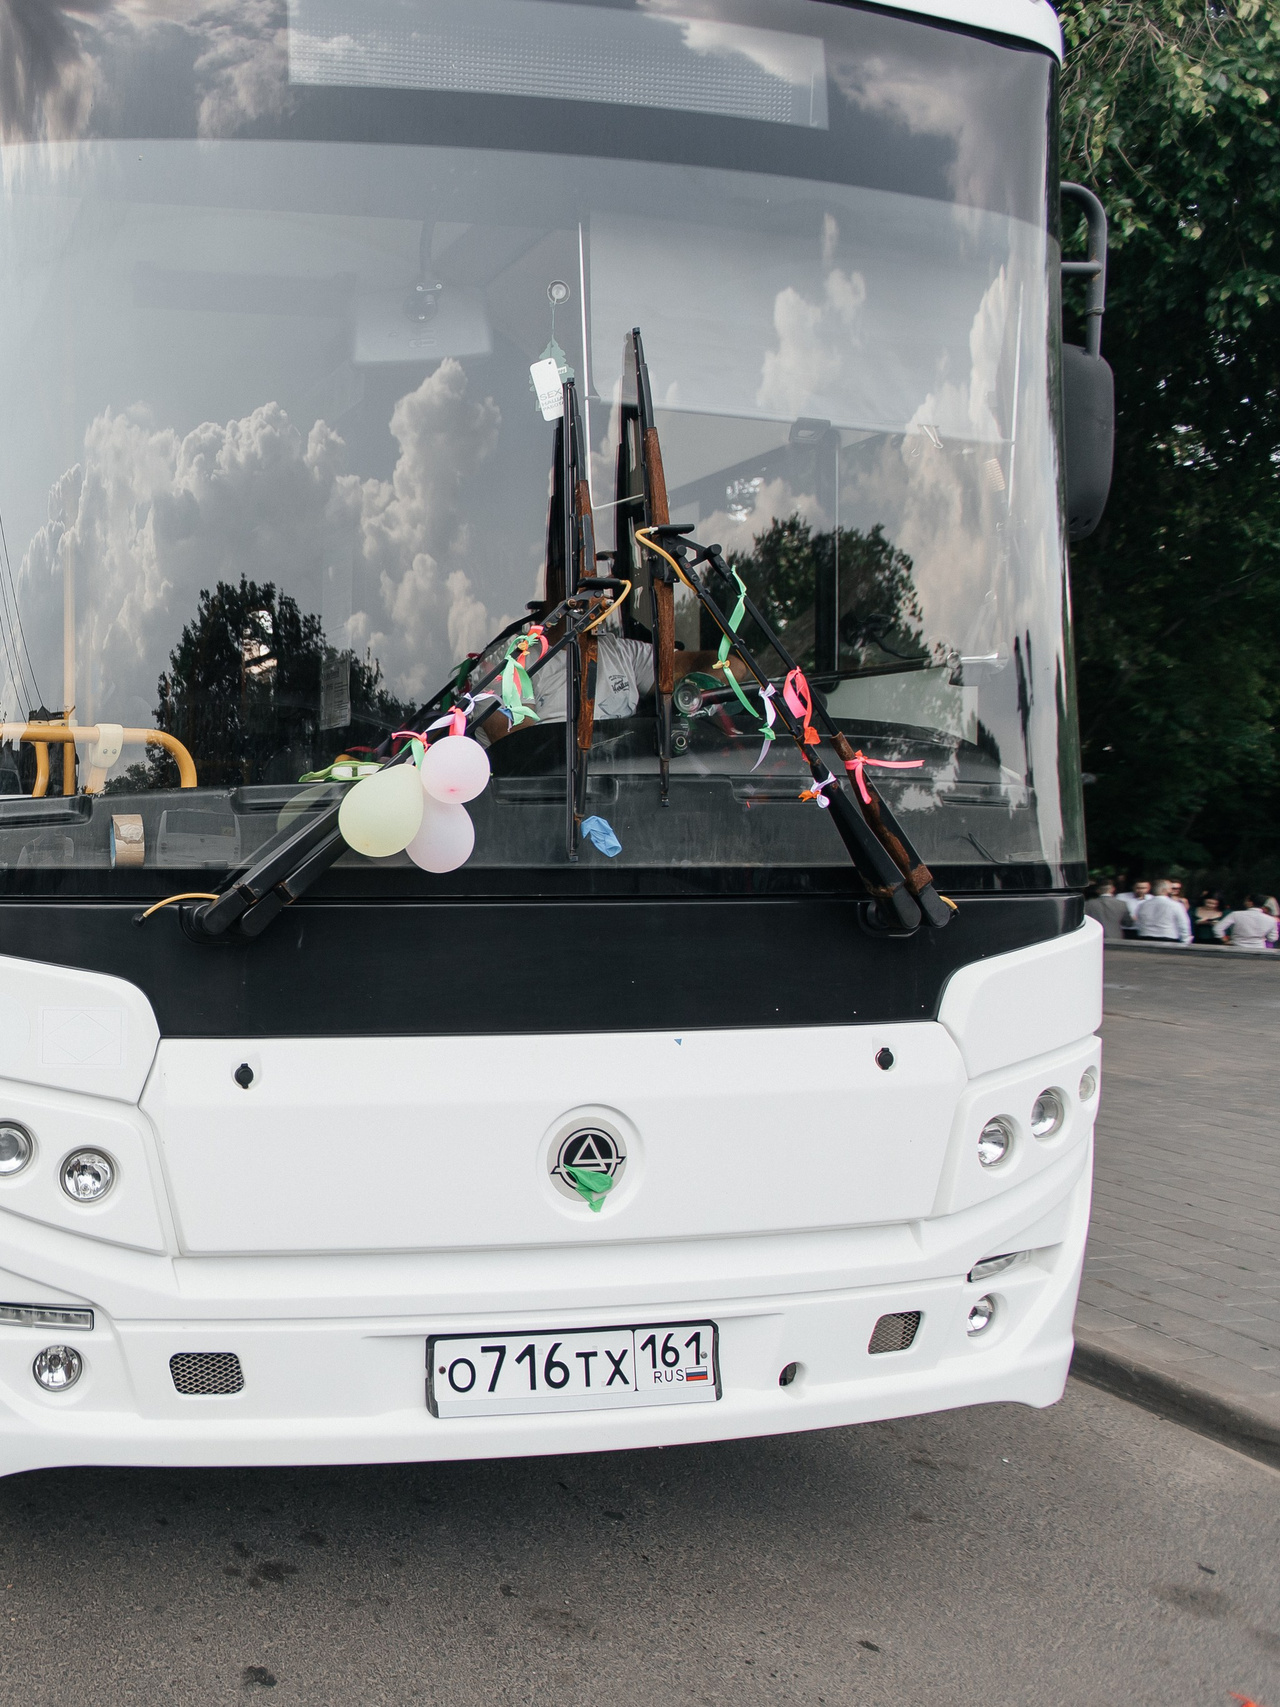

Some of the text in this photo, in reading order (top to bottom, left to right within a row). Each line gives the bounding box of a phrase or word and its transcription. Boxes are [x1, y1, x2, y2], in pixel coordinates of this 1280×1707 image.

[540, 388, 562, 400] SEX
[639, 1331, 701, 1369] 161
[653, 1368, 685, 1384] RUS
